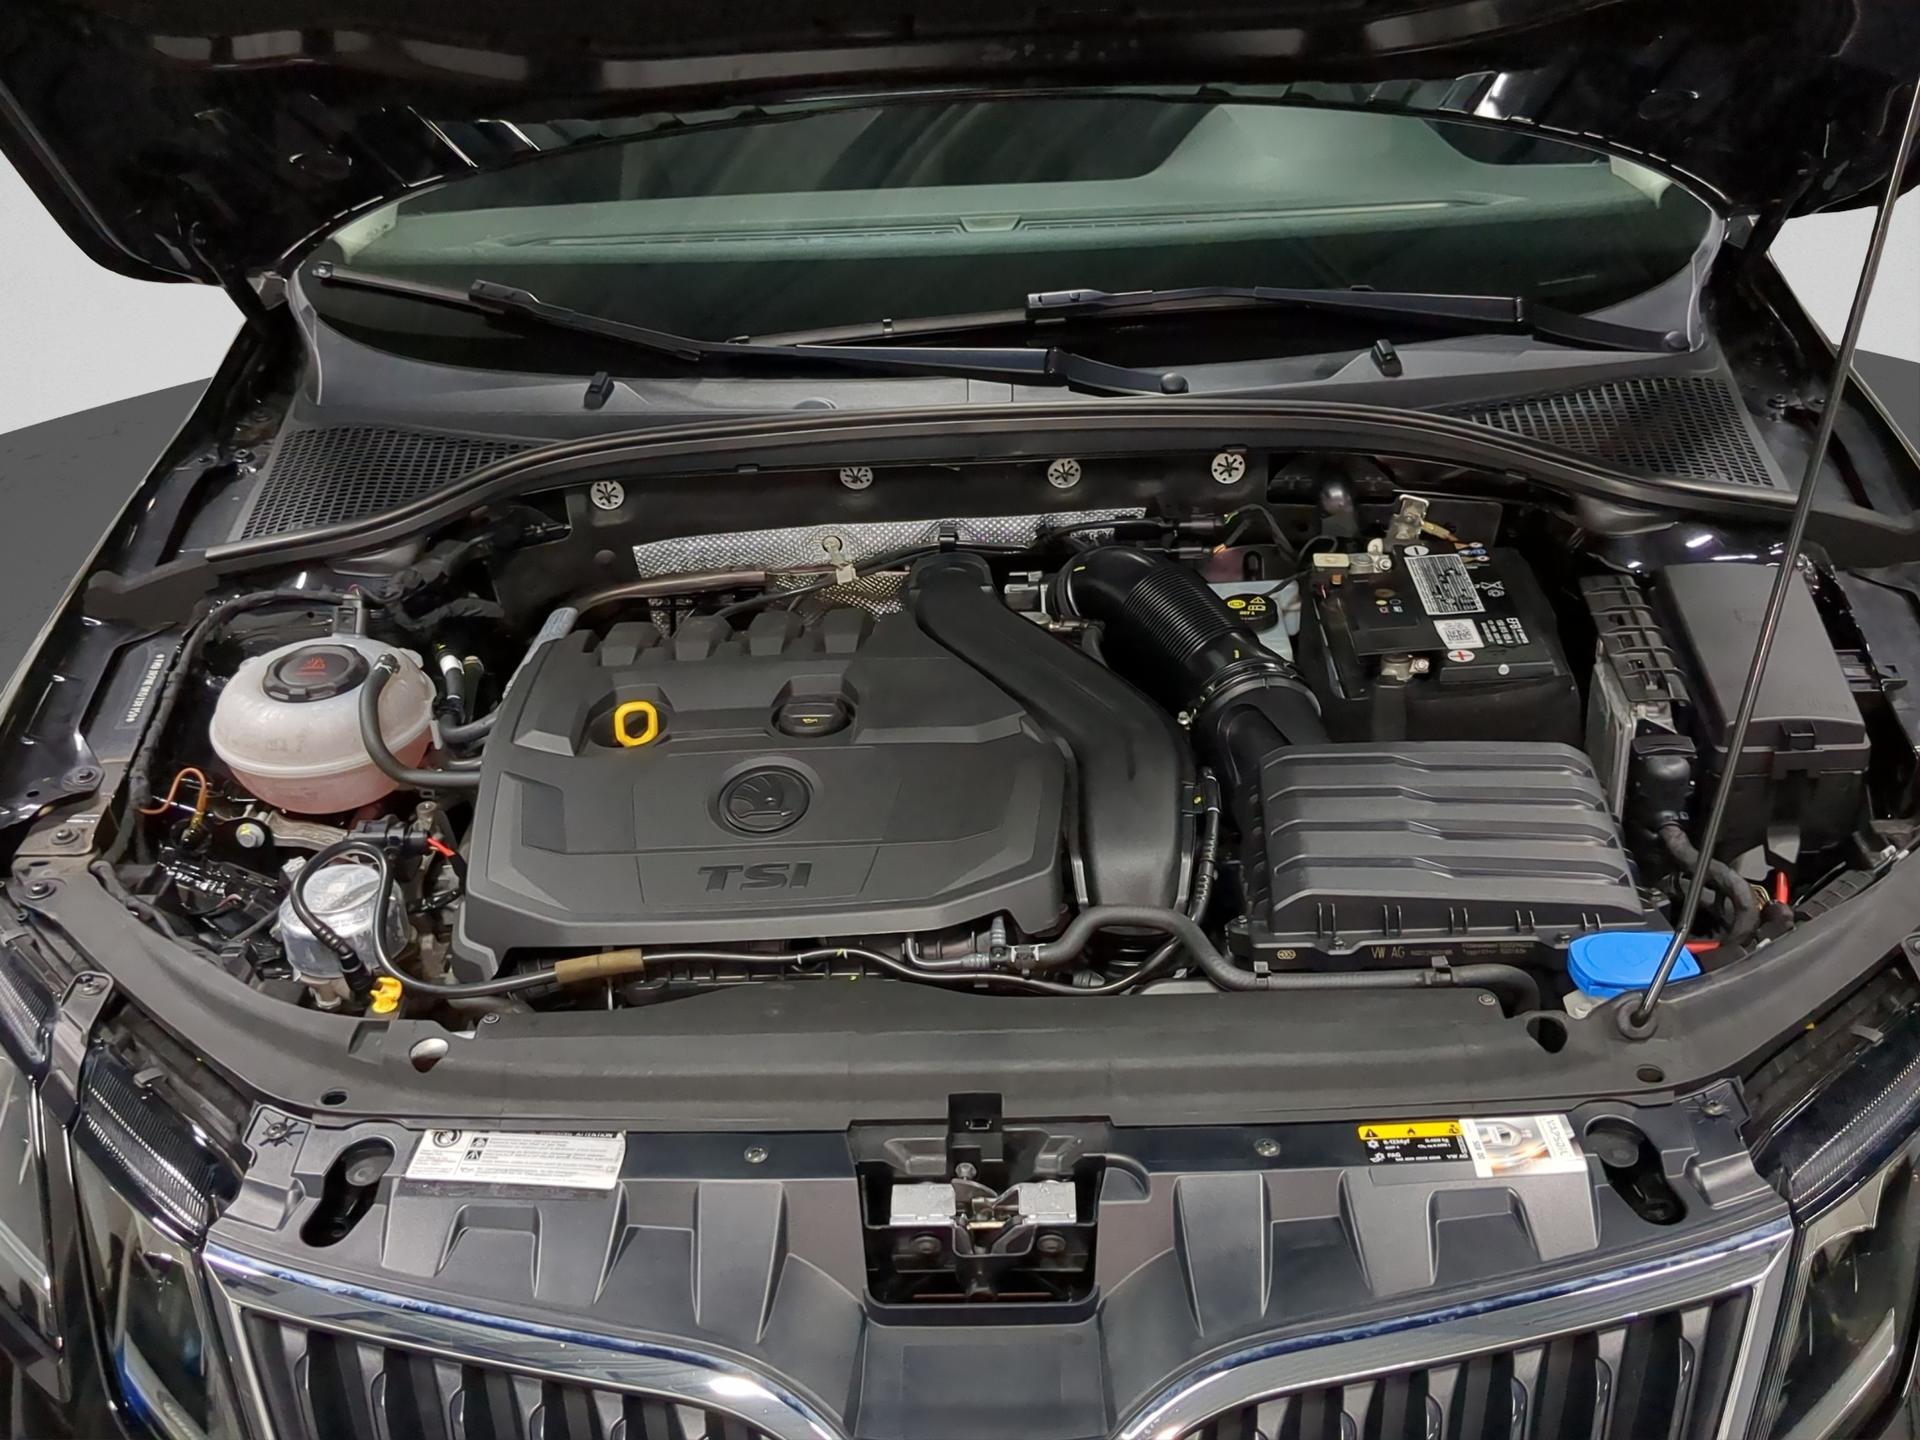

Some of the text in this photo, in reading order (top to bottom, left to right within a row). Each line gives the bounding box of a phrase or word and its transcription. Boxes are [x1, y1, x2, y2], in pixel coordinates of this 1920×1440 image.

[697, 861, 813, 892] TSI
[1371, 946, 1386, 959] VW
[1391, 946, 1405, 959] AG
